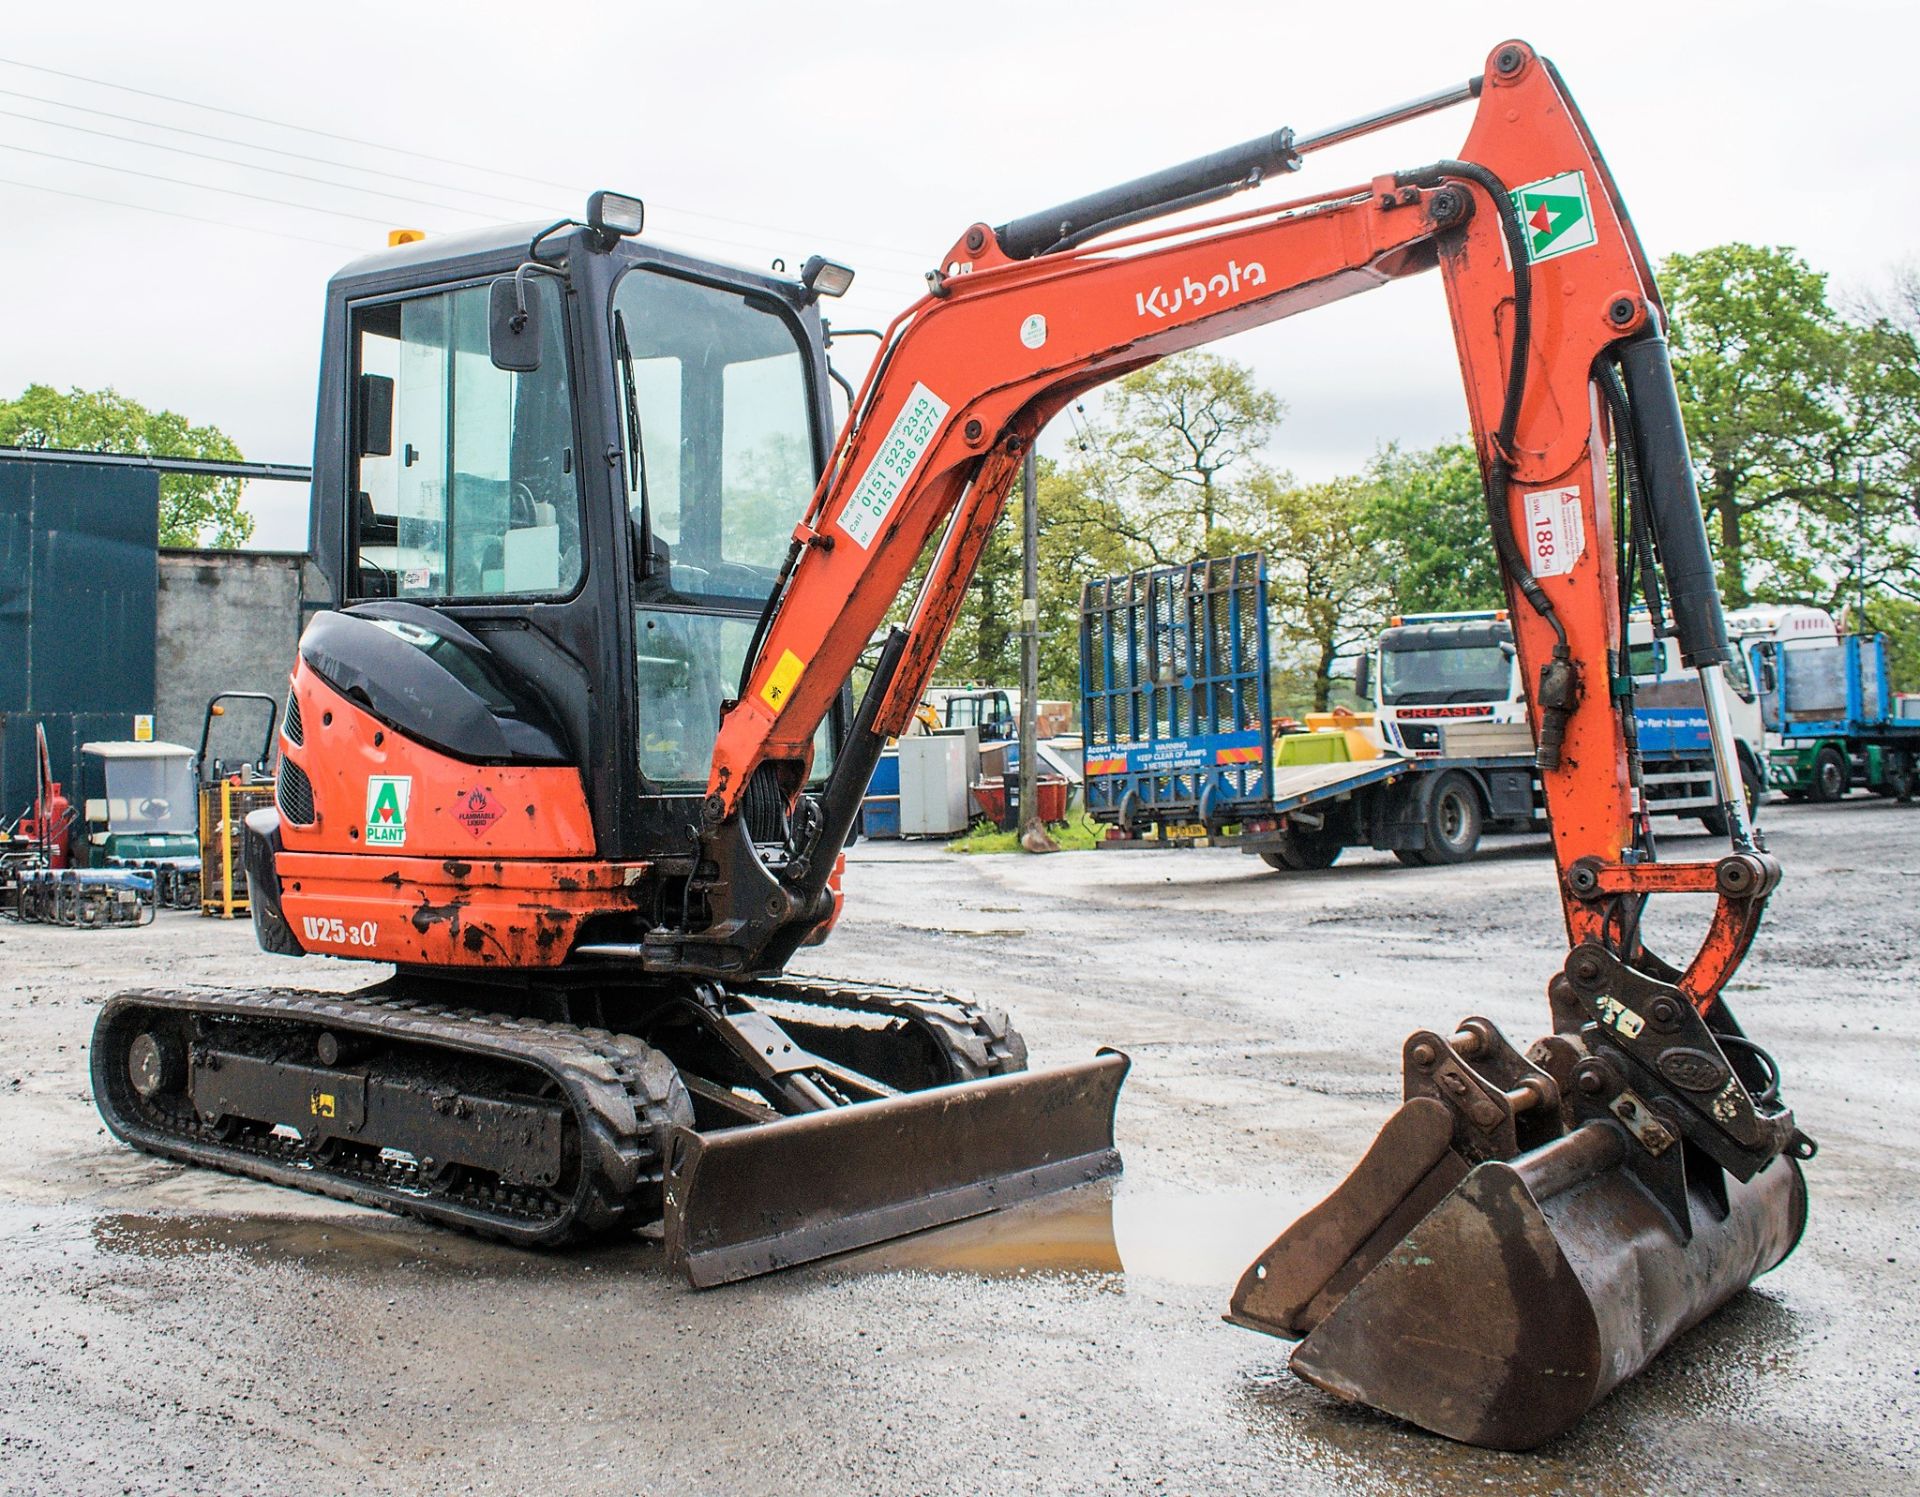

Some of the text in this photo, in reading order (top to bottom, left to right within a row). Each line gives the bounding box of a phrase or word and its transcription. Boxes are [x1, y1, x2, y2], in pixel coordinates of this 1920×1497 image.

[1135, 260, 1267, 318] Kubota
[850, 398, 929, 533] Call 0151 523 2343
[860, 406, 940, 543] or 0151 236 5277
[839, 512, 850, 523] For
[854, 482, 866, 500] your
[865, 441, 889, 481] equipment
[1535, 517, 1555, 557] 188
[1398, 706, 1491, 719] CREASEY
[1087, 742, 1149, 754] Access Platforms
[1155, 741, 1188, 750] WARNING
[1137, 748, 1207, 762] KEEP CLEAR OF RAMPS
[1148, 760, 1173, 770] METRES
[1174, 758, 1201, 768] MINIMUM
[367, 828, 404, 840] PLANT
